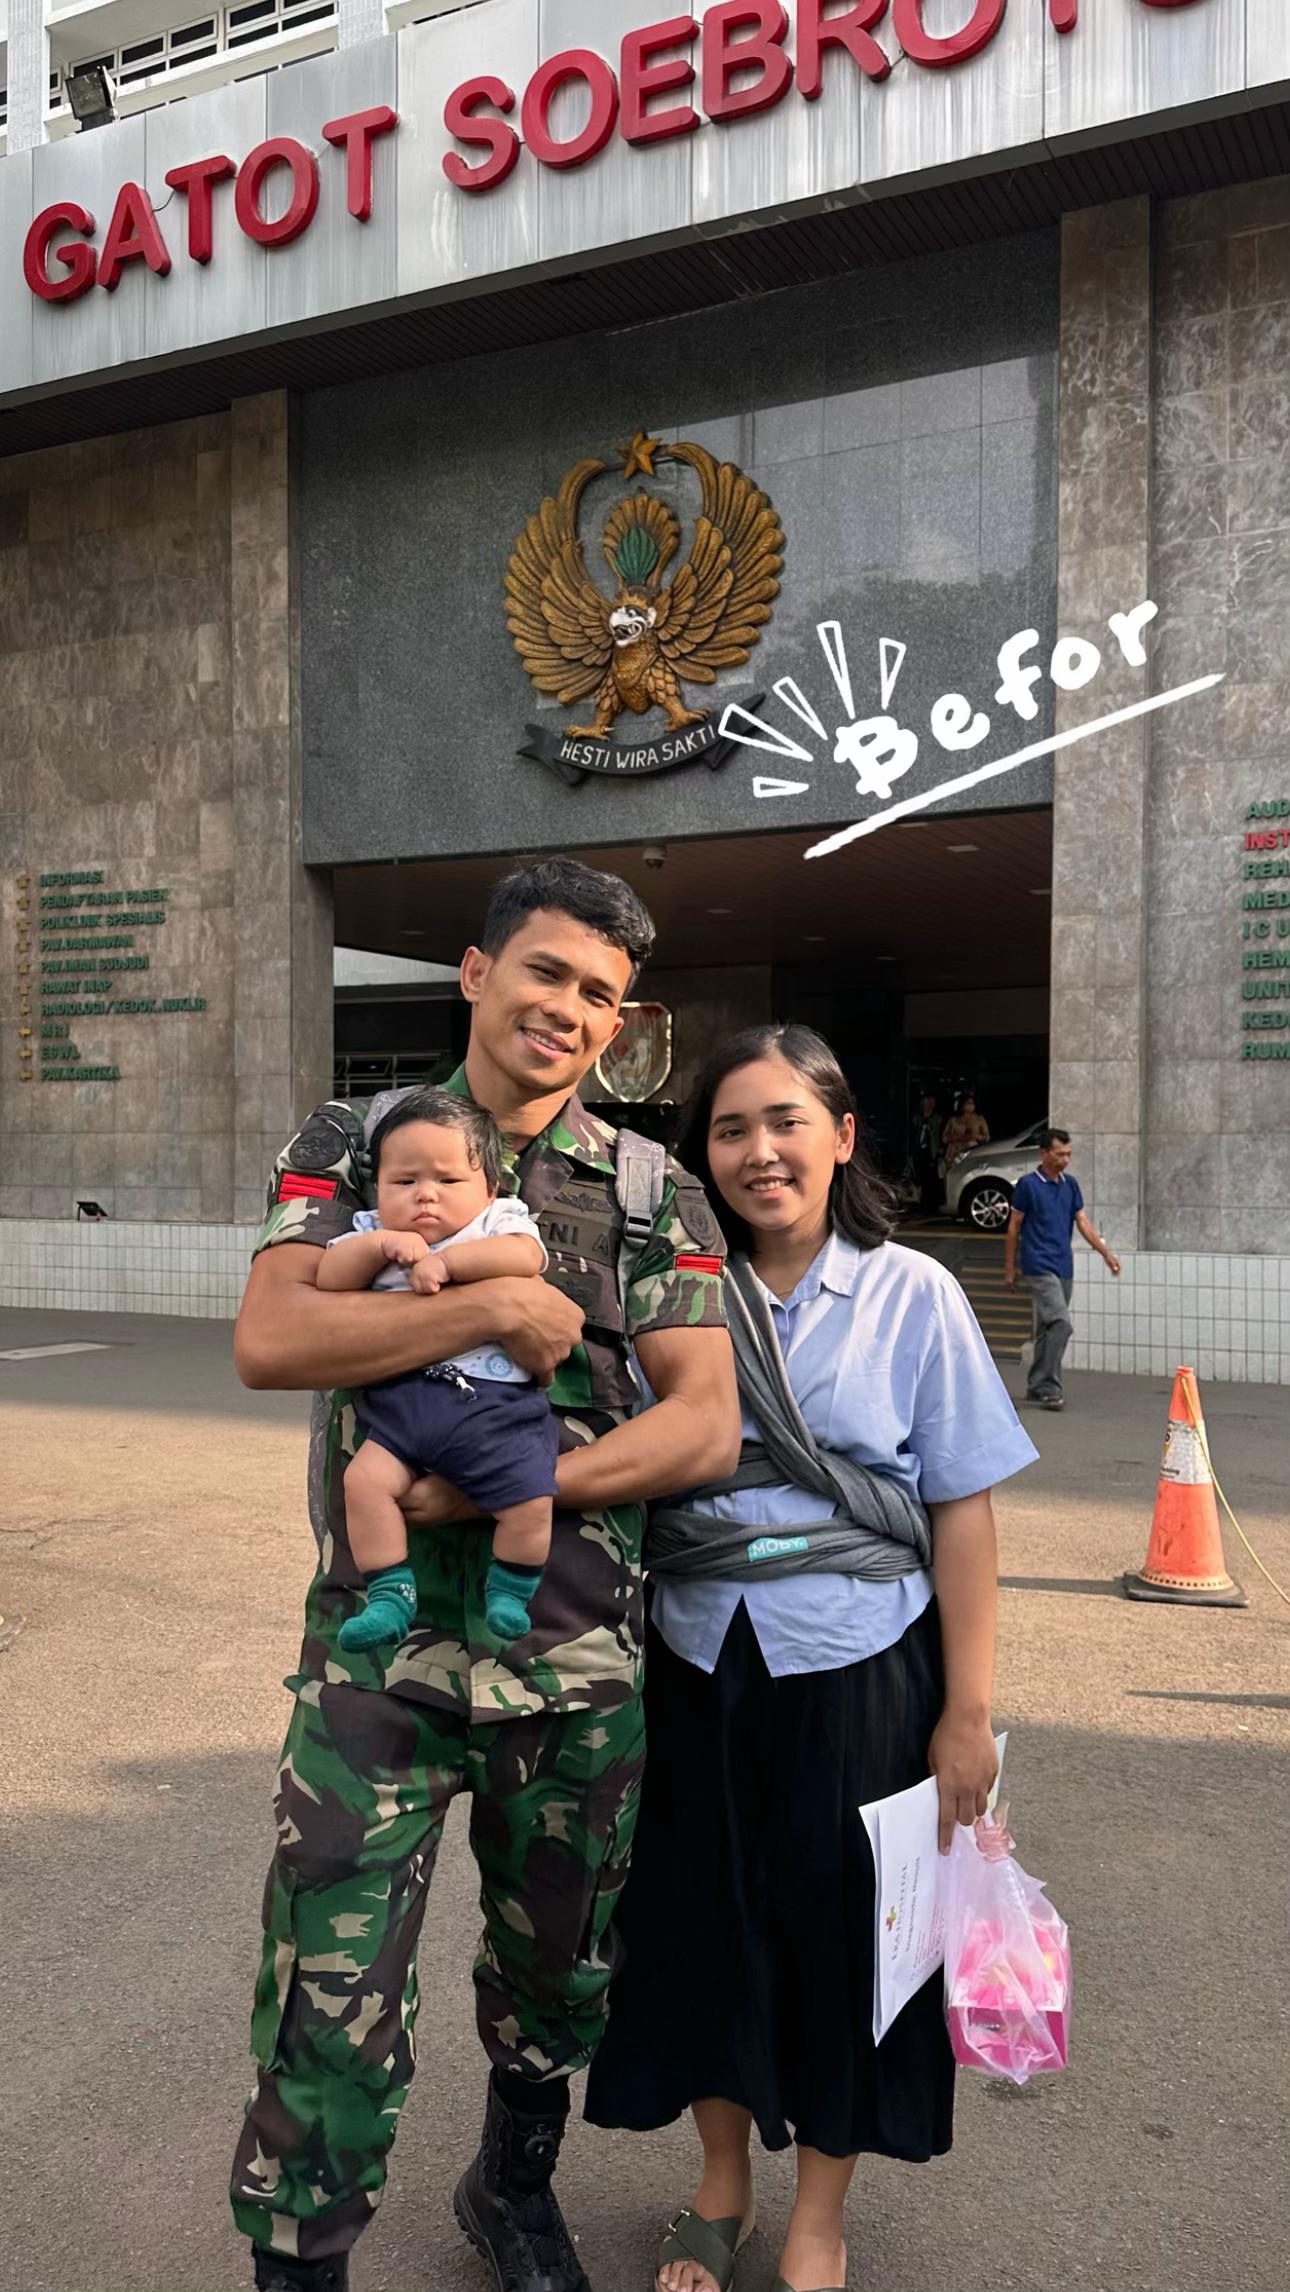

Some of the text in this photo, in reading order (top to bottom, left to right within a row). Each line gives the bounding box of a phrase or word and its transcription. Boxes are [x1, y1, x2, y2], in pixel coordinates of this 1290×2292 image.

[23, 0, 1212, 301] GATOT SOEBRO
[560, 724, 716, 769] HESTI WIRA SAKTI
[1242, 1010, 1290, 1030] KED
